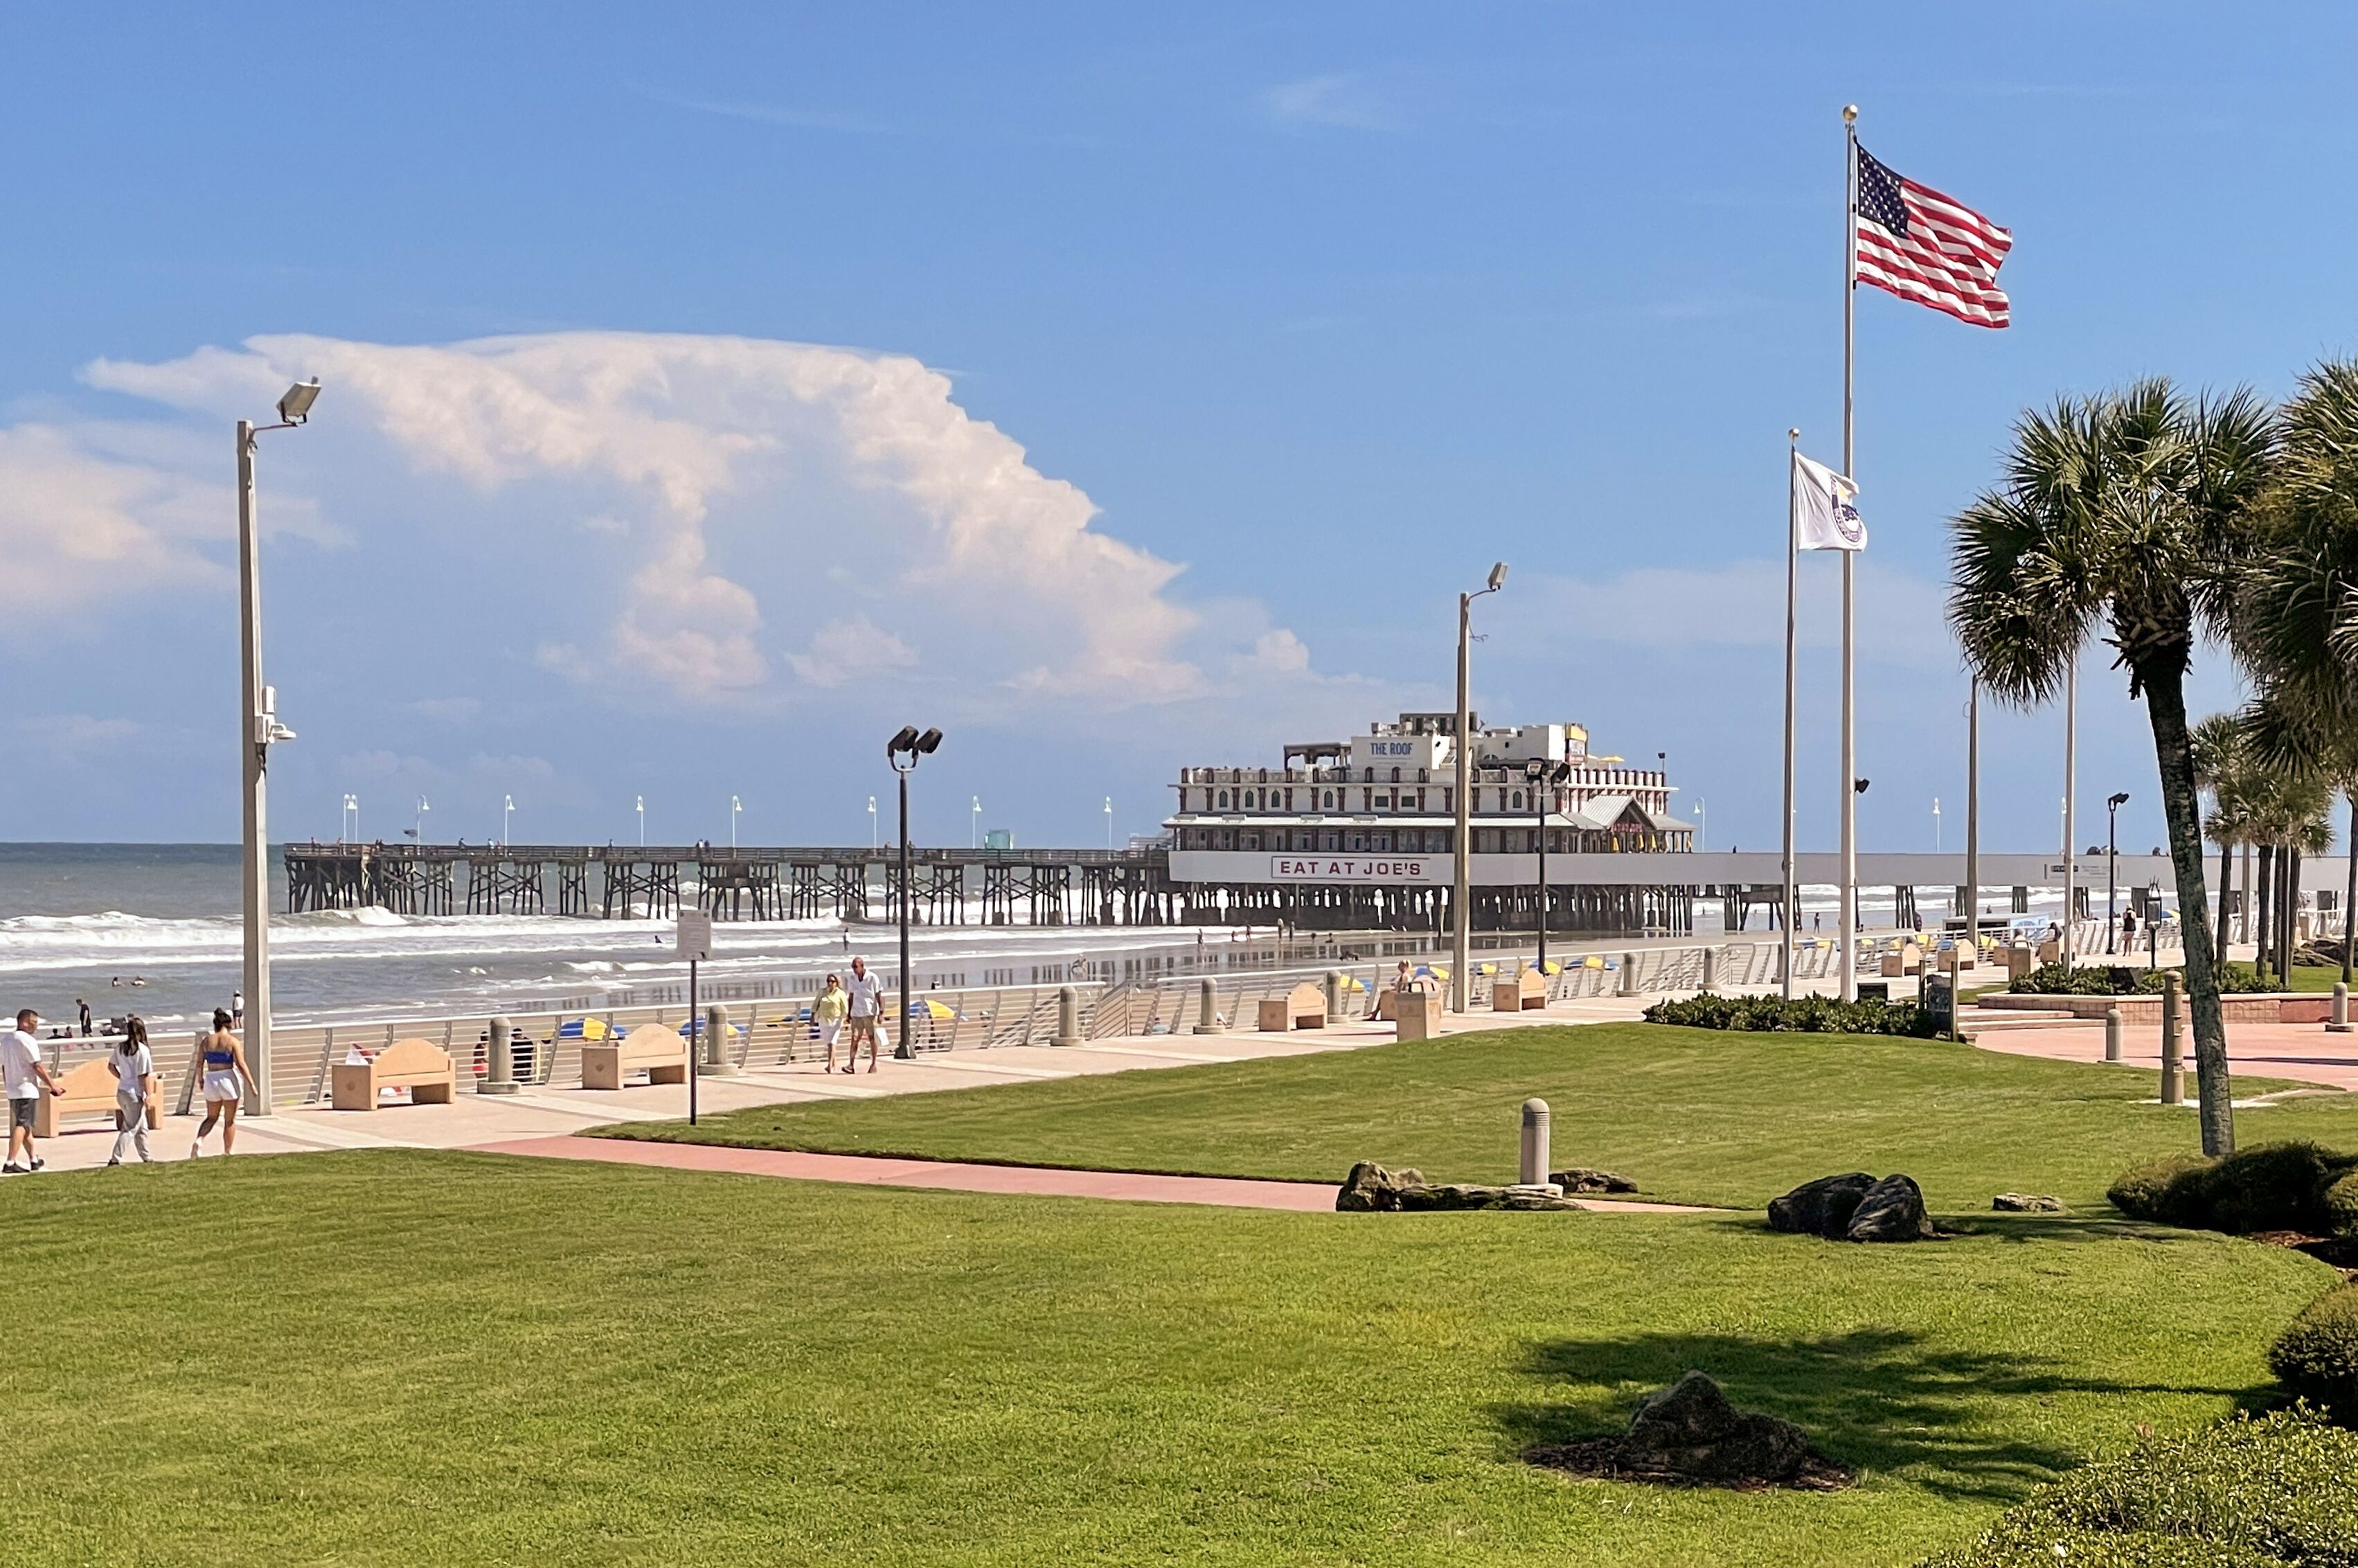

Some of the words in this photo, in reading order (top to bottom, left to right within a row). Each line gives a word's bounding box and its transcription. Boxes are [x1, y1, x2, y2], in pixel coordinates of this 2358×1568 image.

[1370, 742, 1387, 755] THE
[1390, 742, 1413, 755] ROOF
[1280, 861, 1319, 874] EAT
[1328, 862, 1355, 875] AT
[1364, 862, 1420, 875] JOE'S
